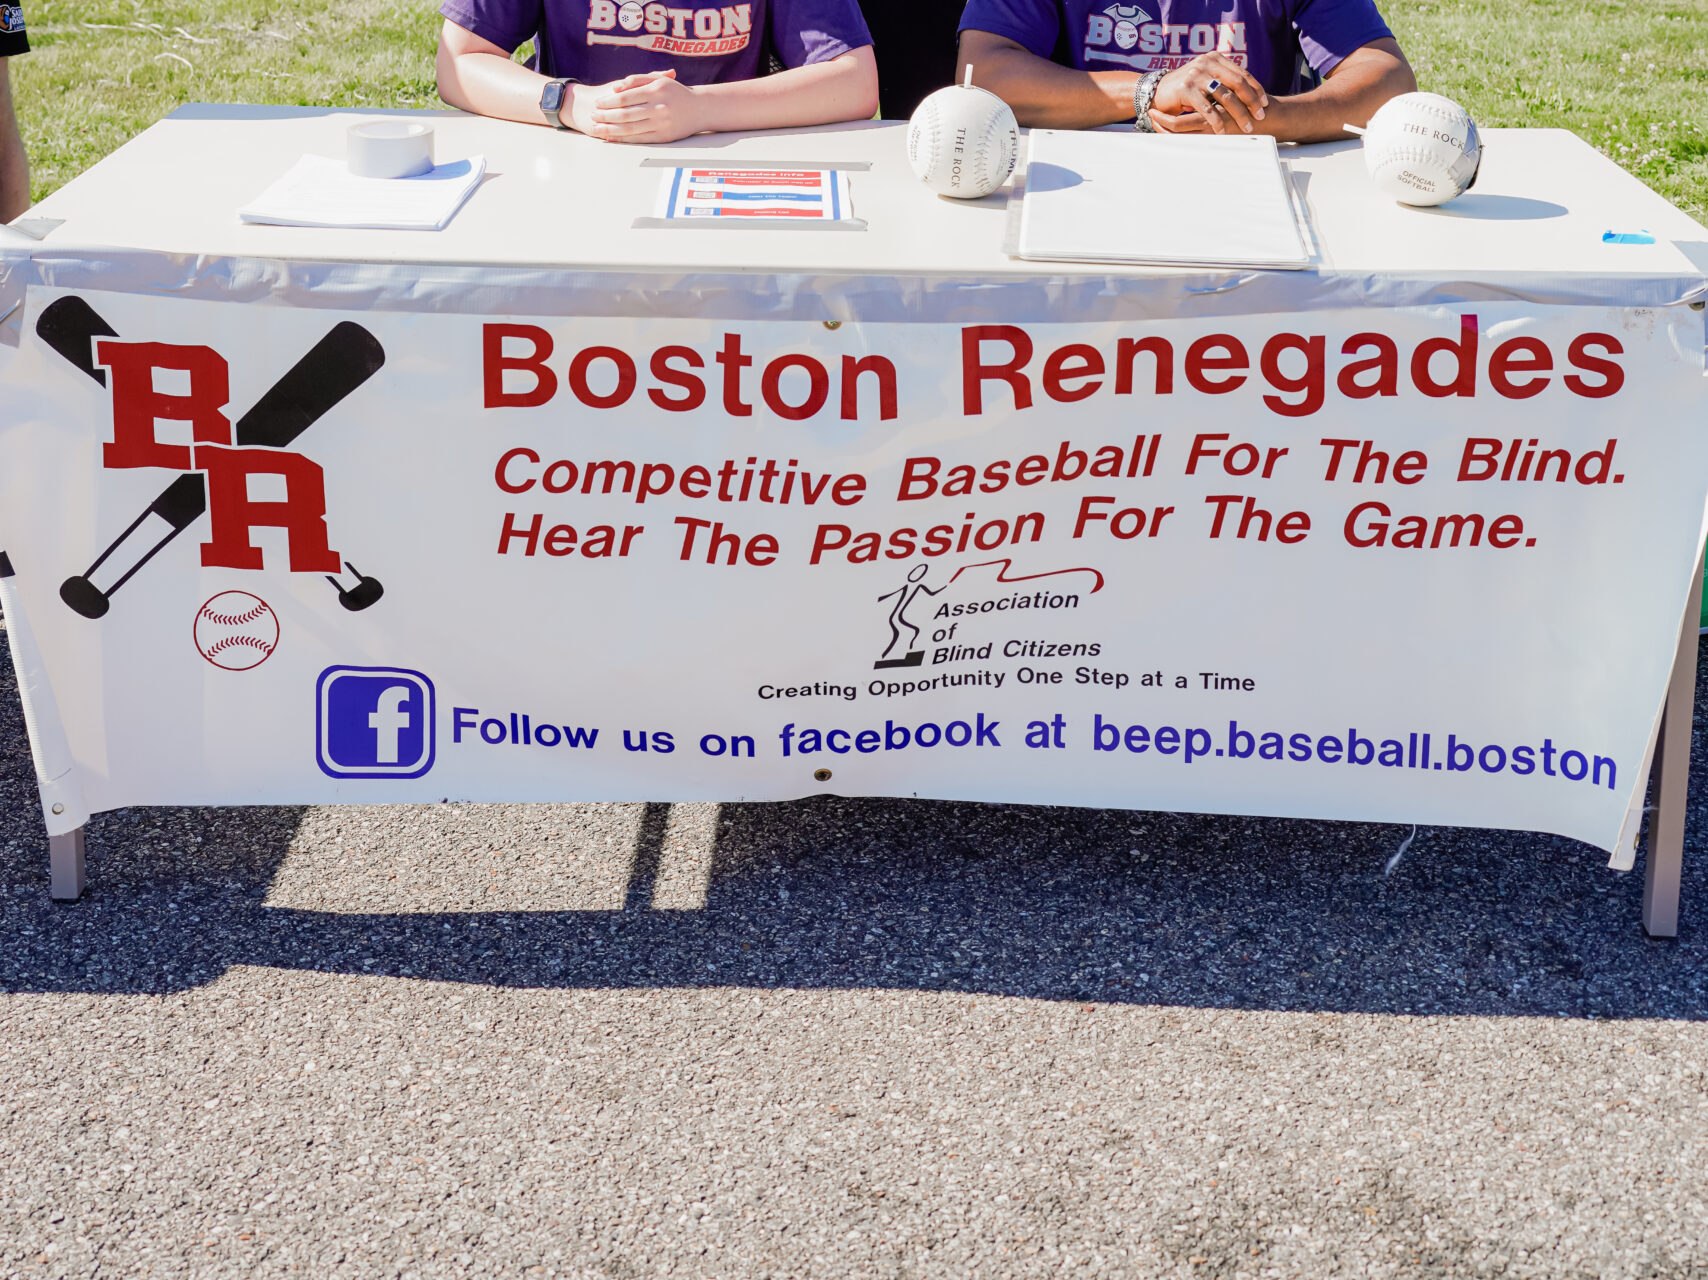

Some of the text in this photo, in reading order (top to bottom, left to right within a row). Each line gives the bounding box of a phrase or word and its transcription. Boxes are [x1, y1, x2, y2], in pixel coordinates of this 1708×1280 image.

[652, 36, 748, 53] RENEGADES
[1402, 123, 1465, 151] THE ROCK
[951, 127, 967, 188] THE ROCK
[1397, 174, 1436, 193] SOFTBALL
[1402, 170, 1436, 187] OFFICIAL
[483, 315, 1625, 421] Boston Renegades
[495, 433, 1626, 506] Competitive Baseball For The Blind.
[497, 495, 1538, 567] Hear The Passion For The Game.
[934, 594, 1080, 620] Association
[931, 623, 958, 643] of
[931, 639, 1102, 665] Blind Citizens
[757, 667, 1256, 702] Creating Opportunity One Step at a Time
[453, 707, 1617, 790] Follow us on facebook at beep.baseball.boston
